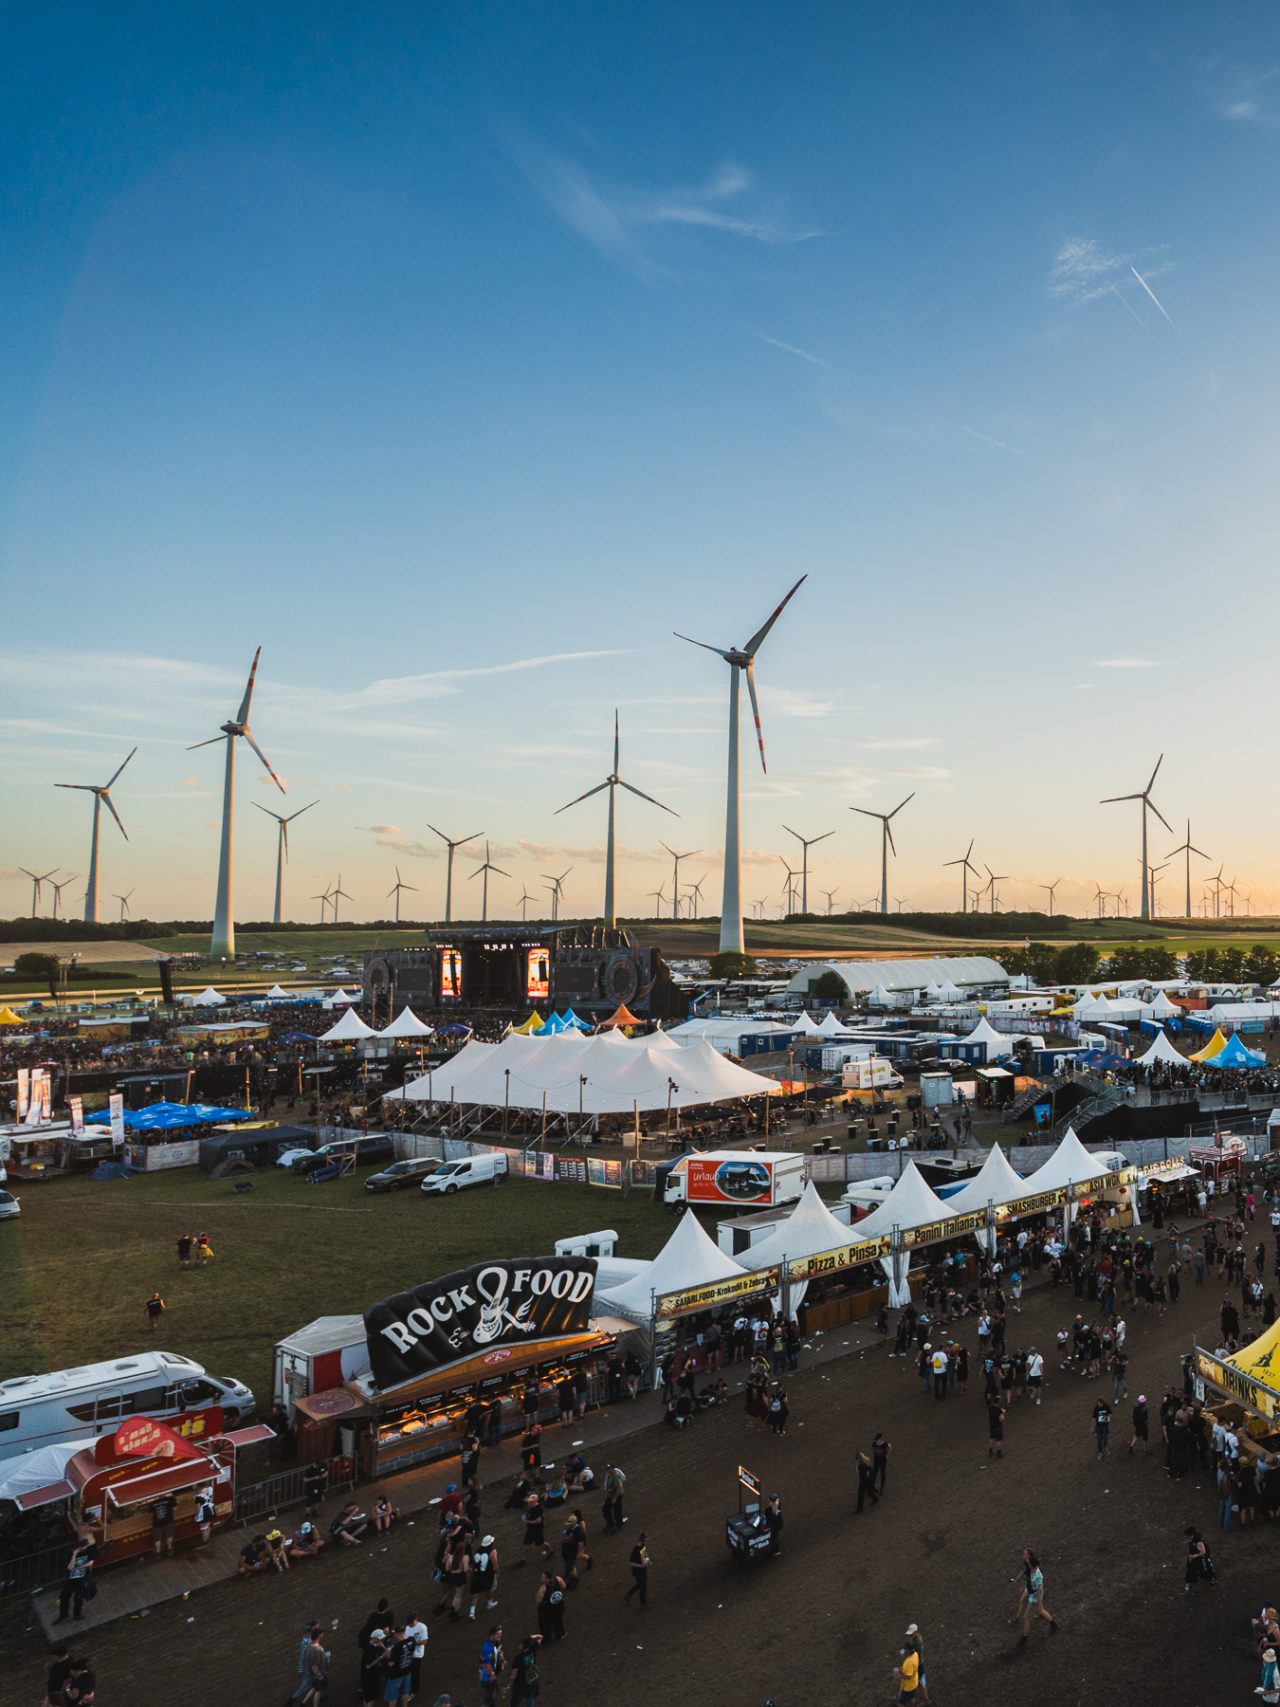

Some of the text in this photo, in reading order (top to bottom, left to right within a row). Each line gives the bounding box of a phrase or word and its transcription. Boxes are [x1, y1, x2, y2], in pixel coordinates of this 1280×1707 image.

[1089, 1176, 1121, 1192] ASIA WOK
[1007, 1192, 1057, 1216] SMASHBURGER
[914, 1216, 976, 1243] Panini italiana
[807, 1243, 877, 1274] Pizza & Pinsa
[380, 1284, 476, 1354] ROCK
[511, 1269, 594, 1303] FOOD
[1222, 1367, 1258, 1407] DRINKS
